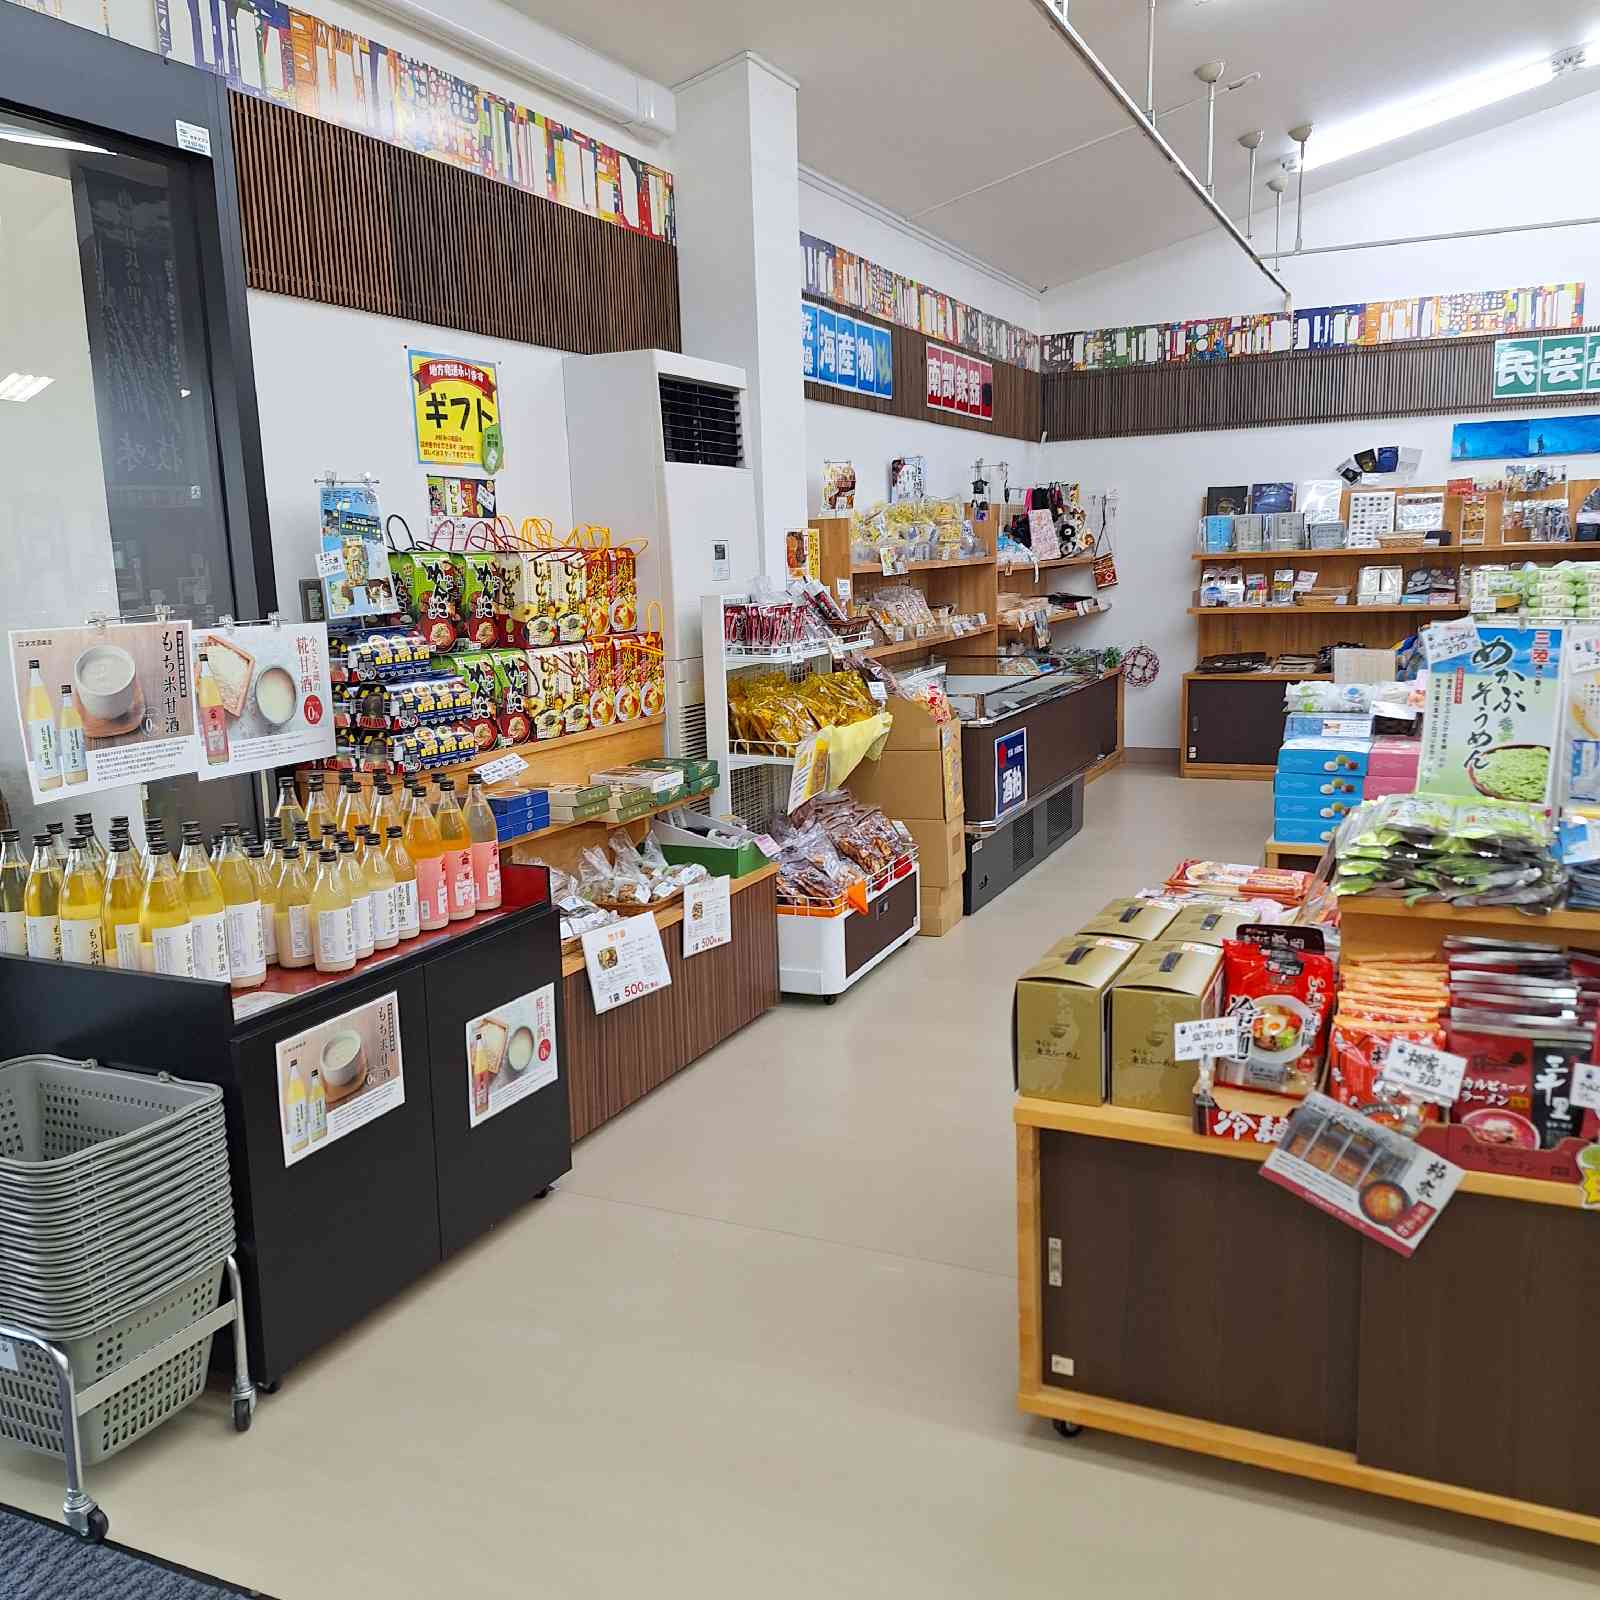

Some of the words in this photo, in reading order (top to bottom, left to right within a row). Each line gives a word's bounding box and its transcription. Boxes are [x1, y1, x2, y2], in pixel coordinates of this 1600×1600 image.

[819, 324, 874, 383] 海産物
[425, 392, 494, 433] ギフト
[161, 631, 180, 733] もち米甘酒
[1472, 637, 1527, 712] めかぶ
[1463, 682, 1494, 769] そうめん
[1460, 1091, 1510, 1106] ラーメン
